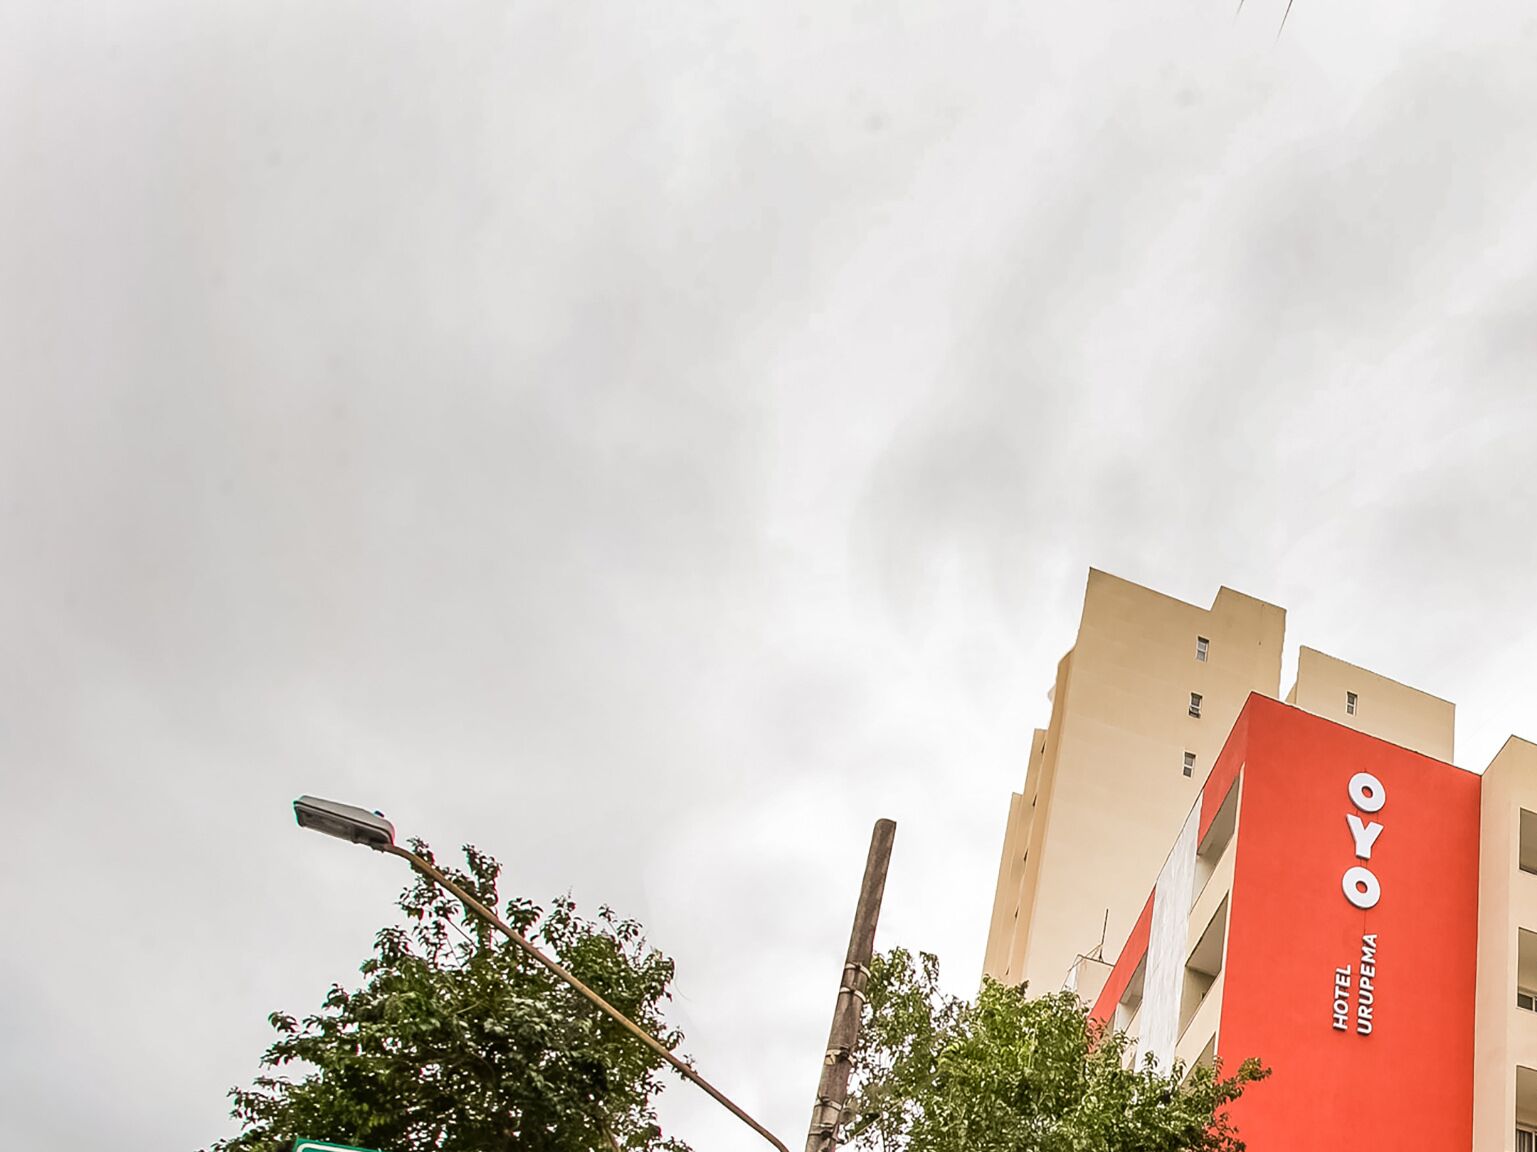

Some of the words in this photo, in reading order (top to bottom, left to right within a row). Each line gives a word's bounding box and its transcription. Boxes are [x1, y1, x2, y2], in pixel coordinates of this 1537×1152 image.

[1342, 772, 1386, 909] OYO
[1333, 964, 1351, 1031] HOTEL
[1356, 934, 1377, 1035] URUPEMA
